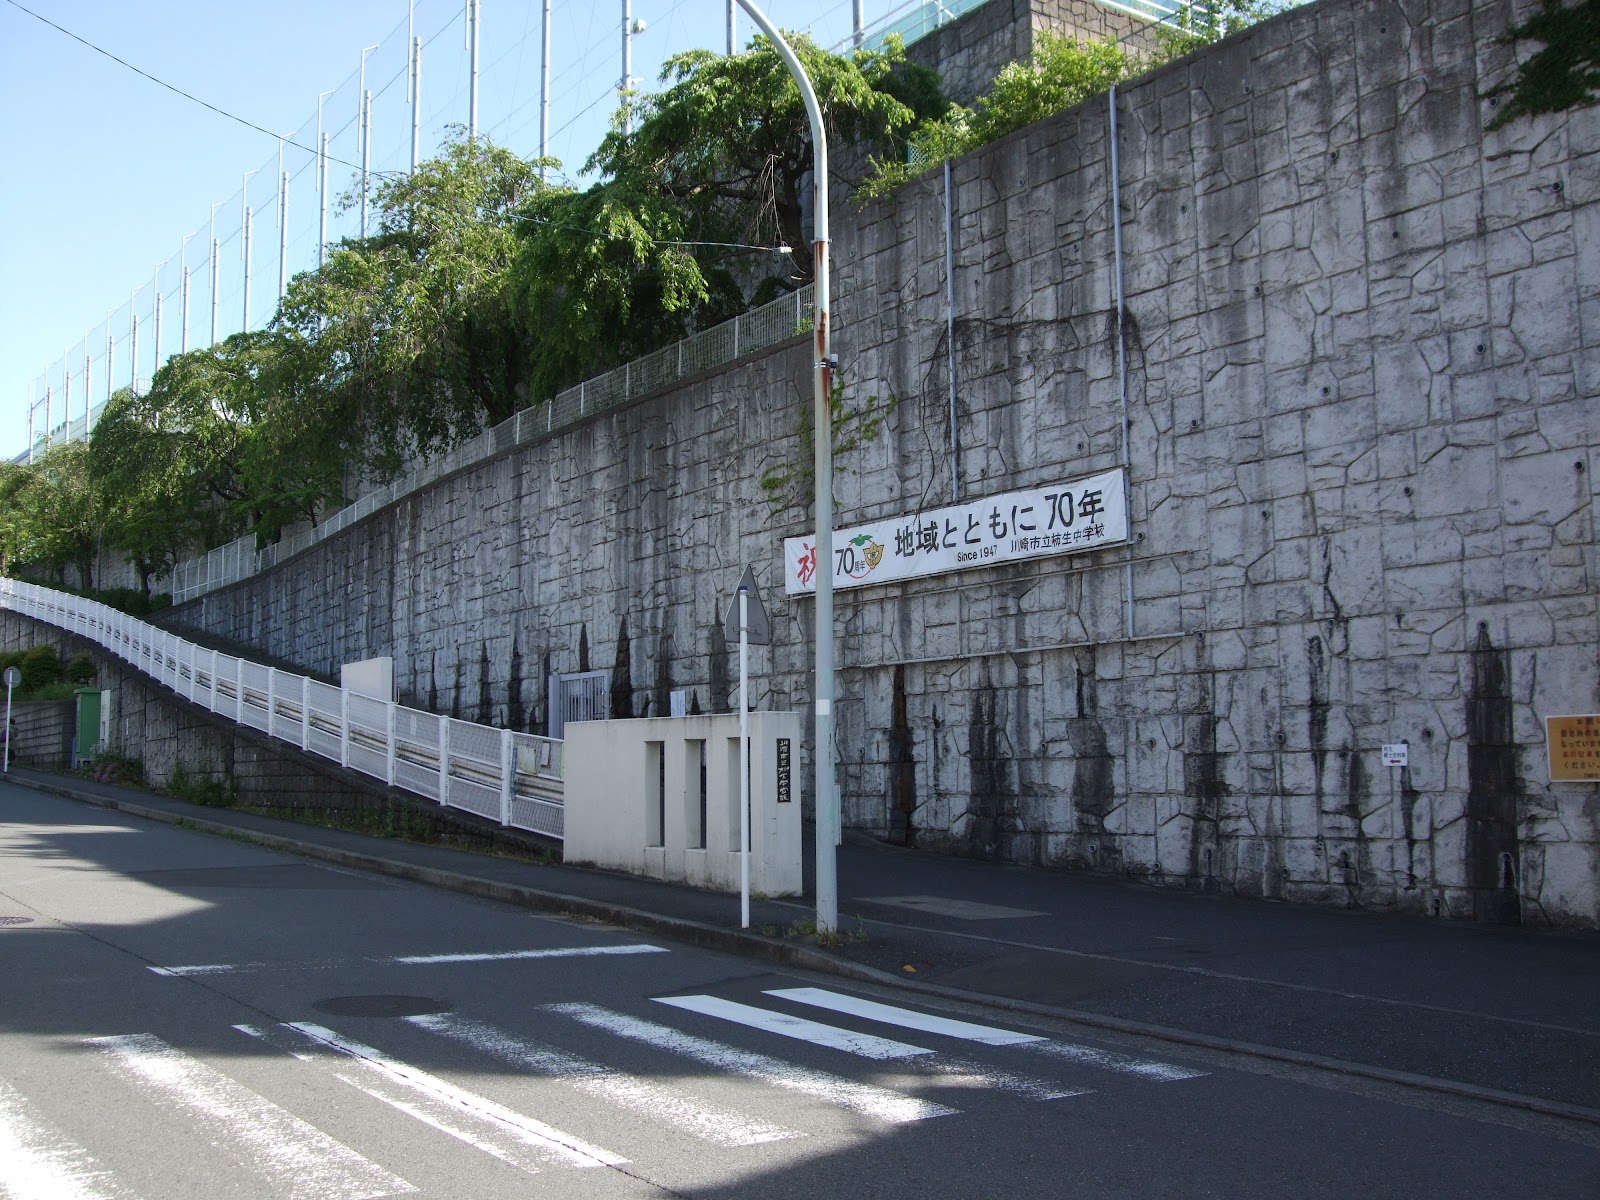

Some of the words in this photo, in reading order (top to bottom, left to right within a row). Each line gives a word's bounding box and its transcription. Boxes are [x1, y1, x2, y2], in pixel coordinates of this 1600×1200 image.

[1011, 523, 1105, 553] 川崎市立柿生中学校
[957, 550, 978, 562] Since
[979, 545, 998, 558] 1947
